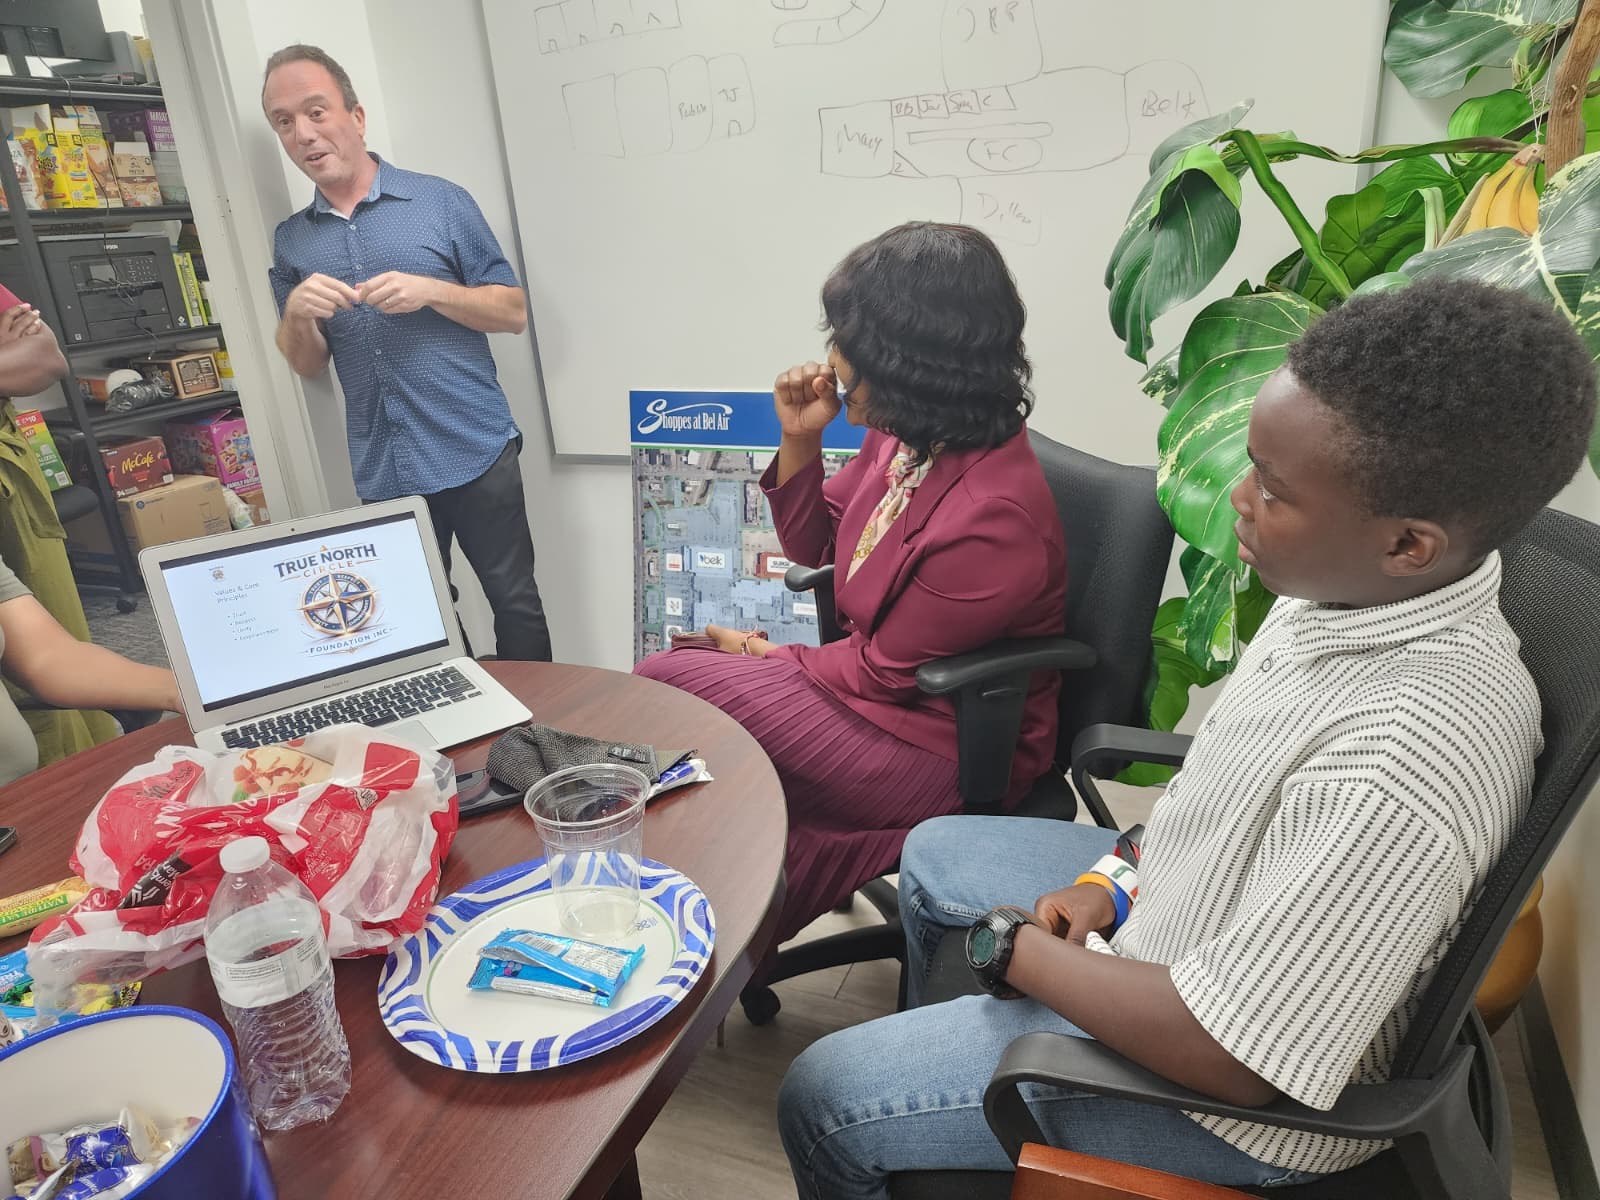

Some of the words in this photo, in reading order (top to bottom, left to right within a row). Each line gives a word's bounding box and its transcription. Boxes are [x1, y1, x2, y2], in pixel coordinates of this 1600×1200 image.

[637, 398, 692, 434] Shoppes
[693, 414, 702, 430] at
[702, 412, 715, 430] Bel
[717, 412, 731, 431] Air
[273, 555, 318, 579] TRUE
[320, 543, 377, 564] NORTH
[303, 560, 354, 579] CIRCLE
[703, 553, 724, 567] belk
[310, 634, 371, 654] FOUNDATION
[373, 628, 389, 639] INC
